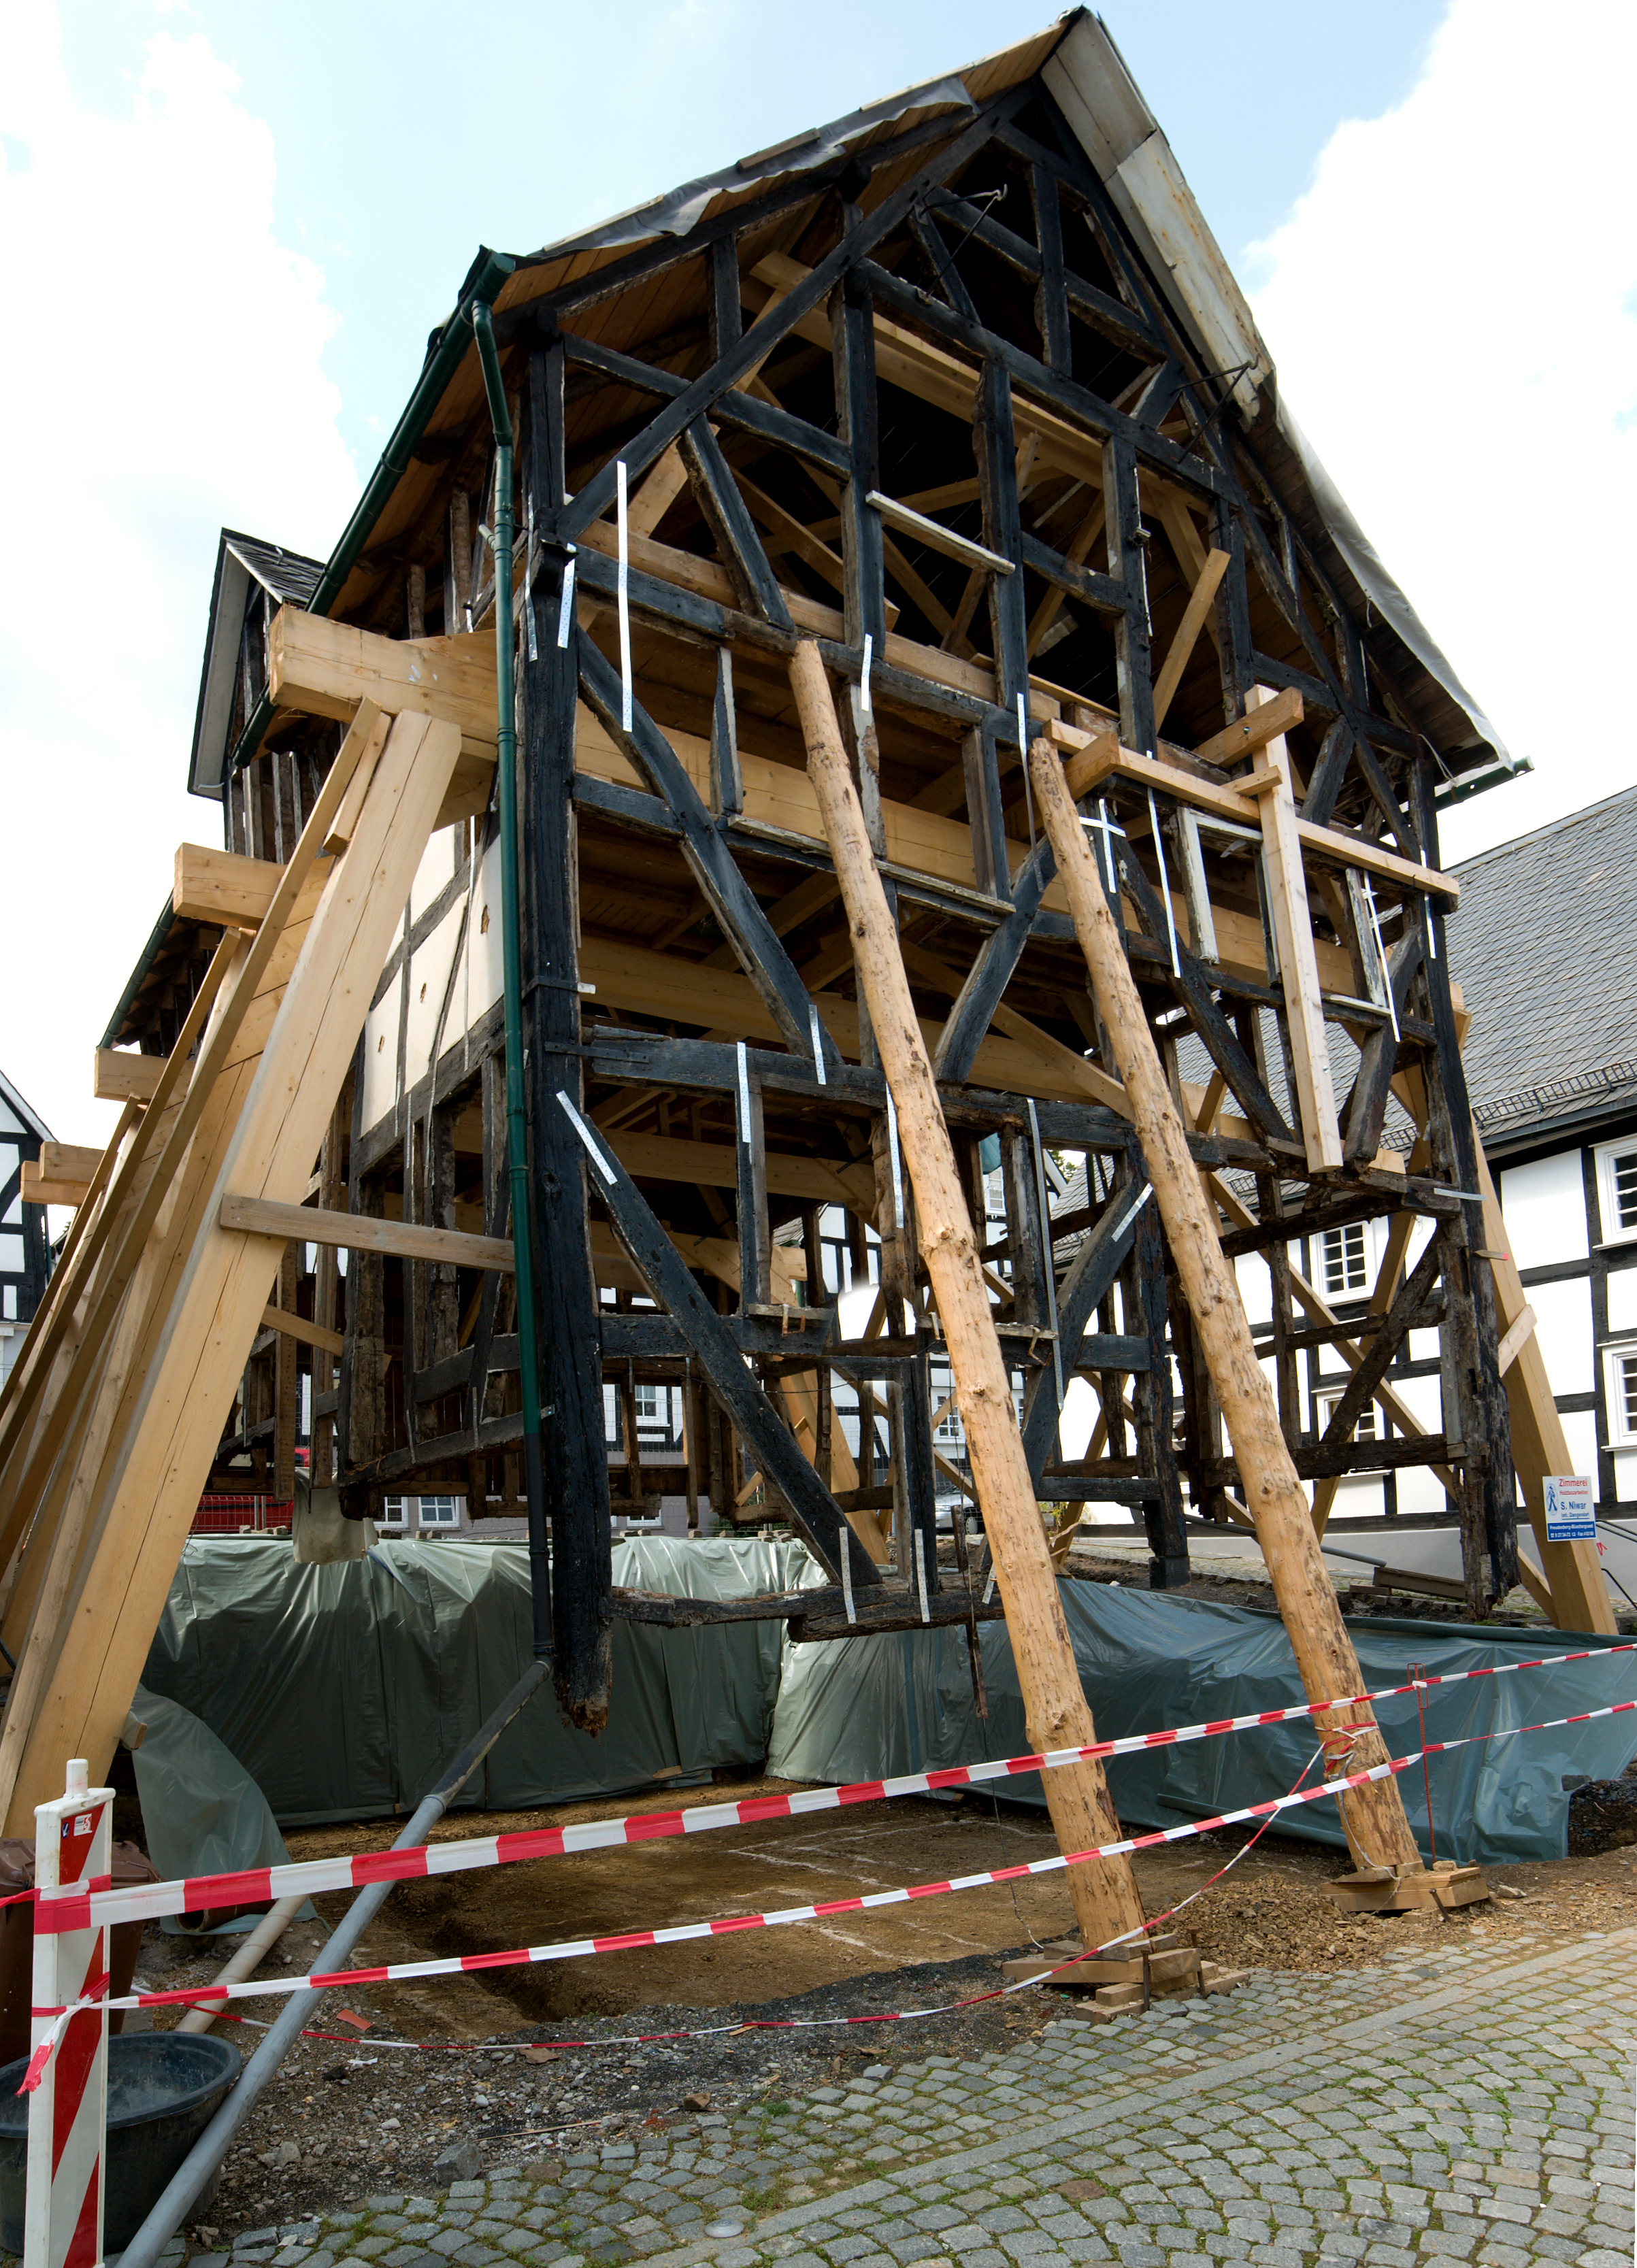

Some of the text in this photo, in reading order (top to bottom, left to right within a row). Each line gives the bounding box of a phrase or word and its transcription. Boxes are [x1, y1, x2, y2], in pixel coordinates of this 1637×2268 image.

[1559, 1478, 1588, 1487] Zimmerei
[1561, 1501, 1586, 1510] S. Niwar
